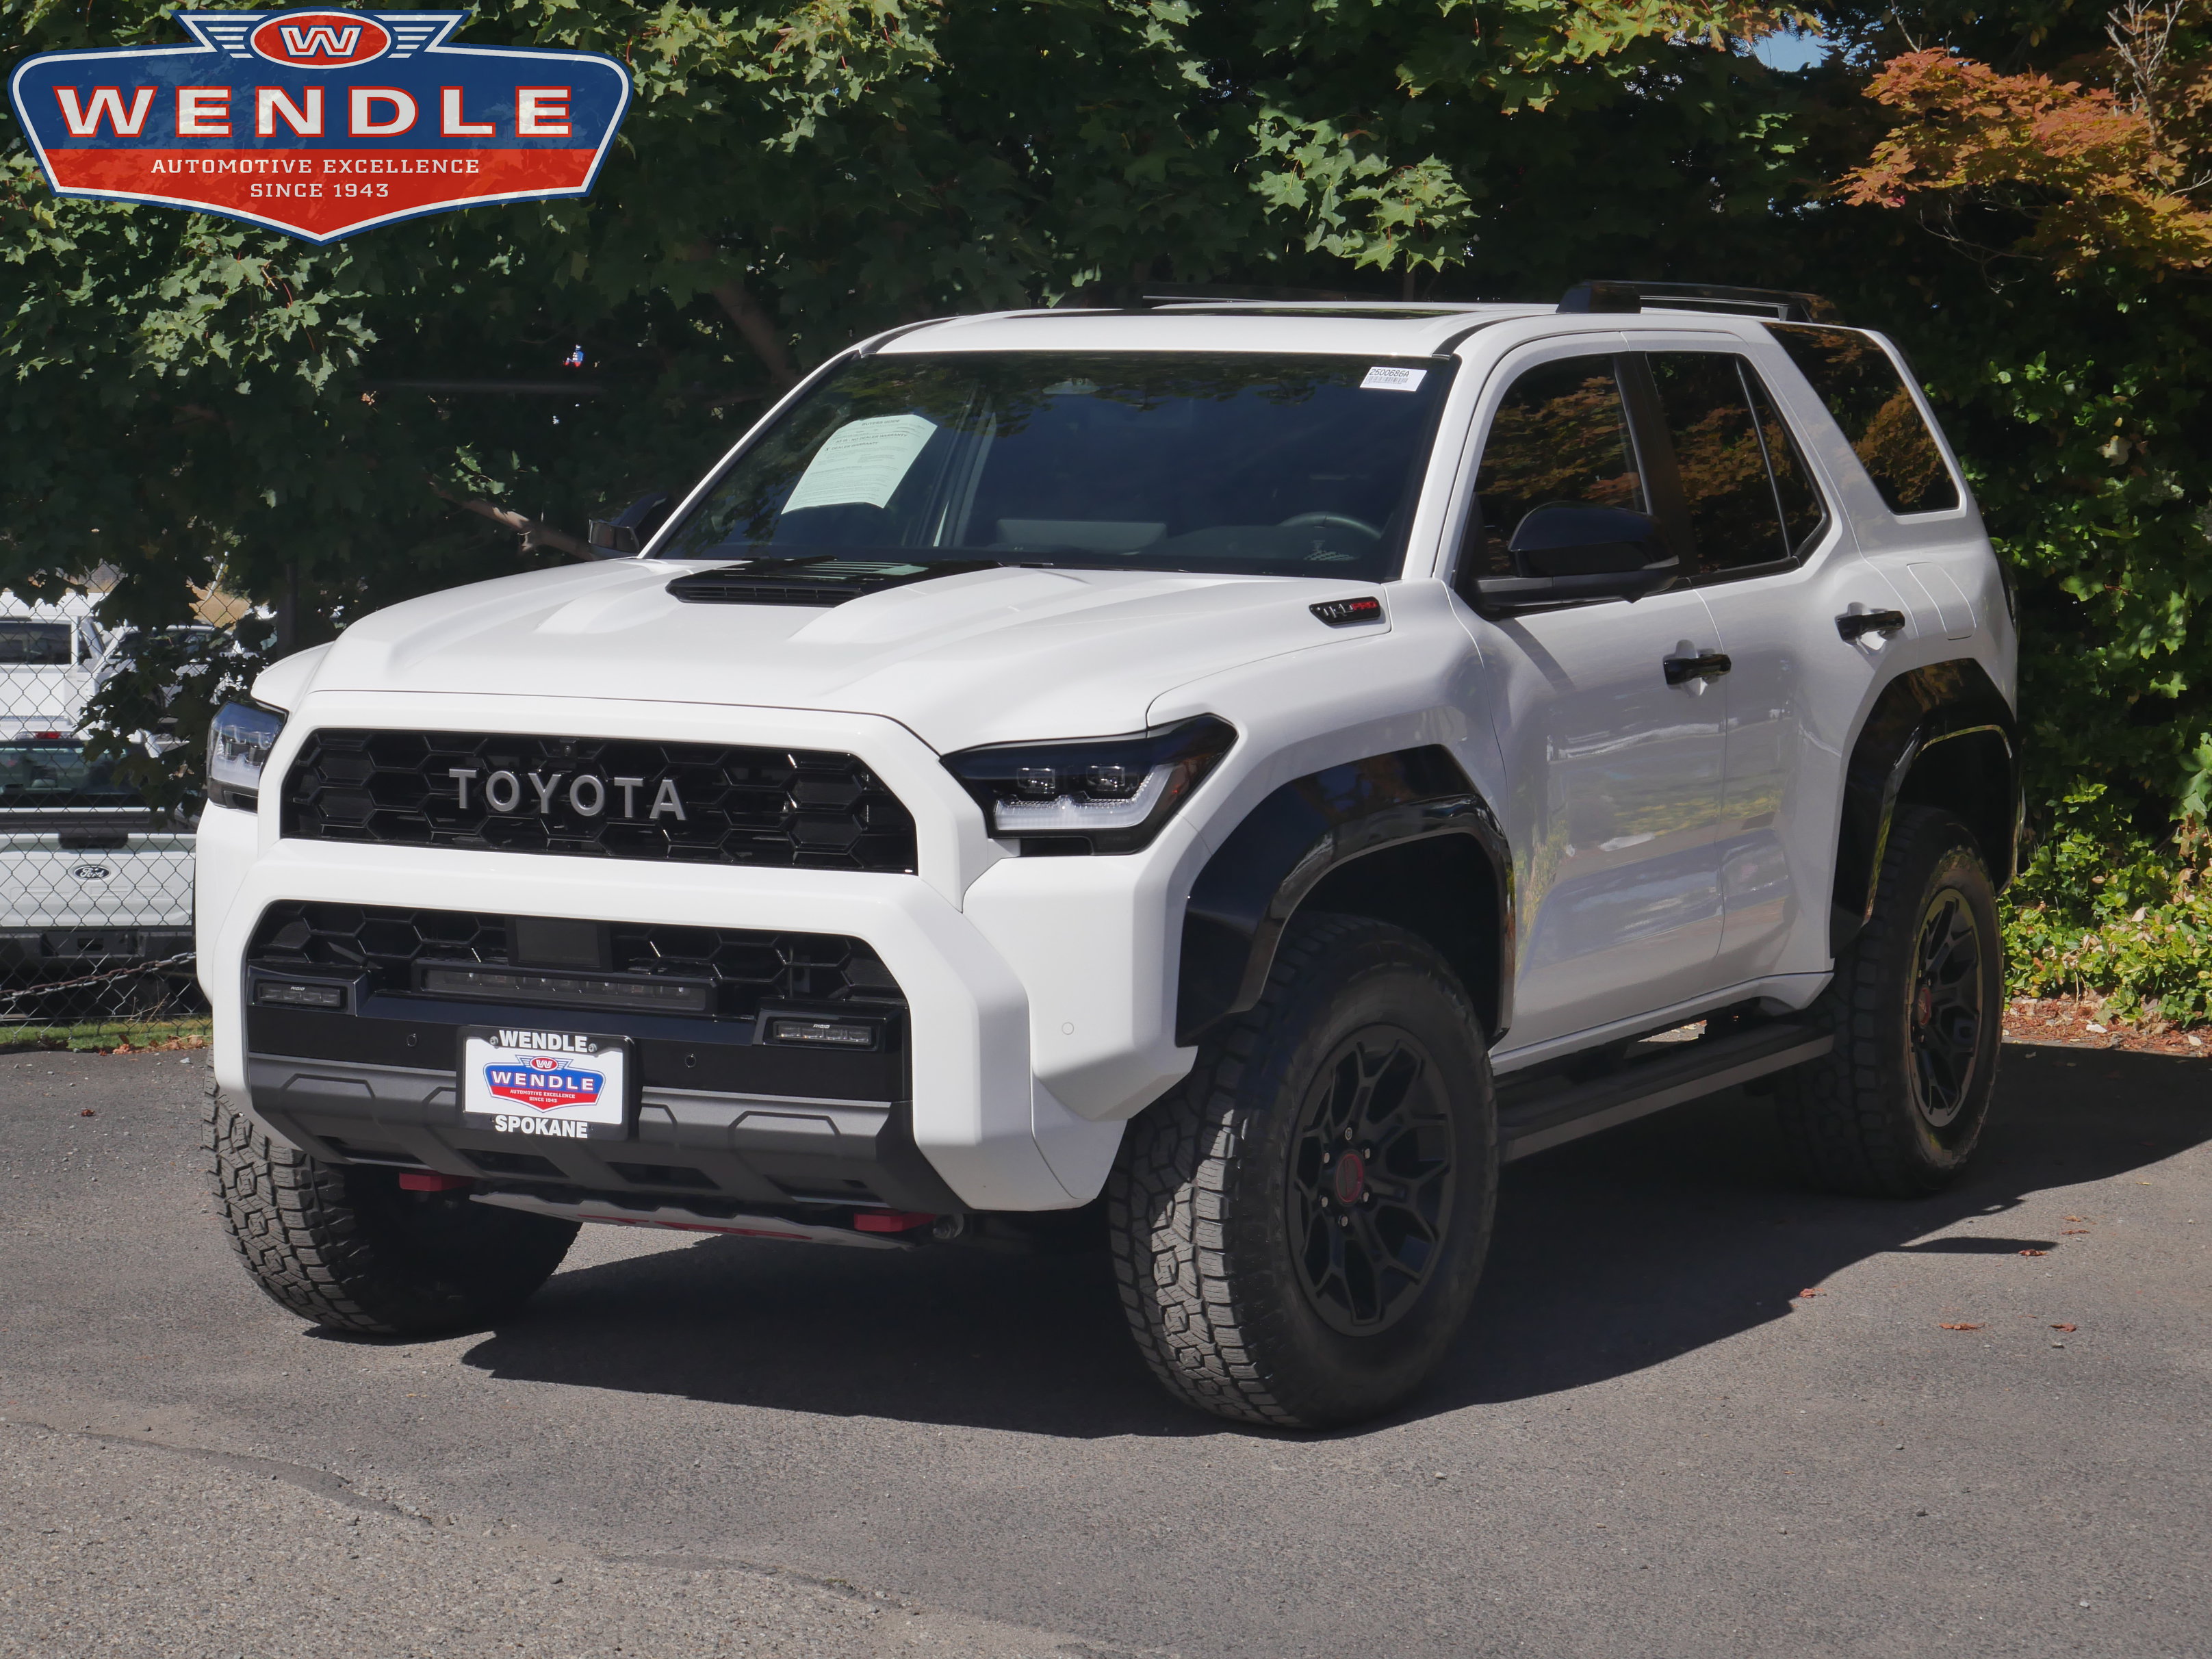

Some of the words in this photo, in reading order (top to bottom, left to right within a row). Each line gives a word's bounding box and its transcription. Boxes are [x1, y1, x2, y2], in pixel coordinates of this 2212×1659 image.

[1369, 369, 1410, 377] 2500686A
[1351, 602, 1378, 610] PRO
[448, 768, 686, 821] TOYOTA
[80, 867, 104, 878] Ford
[499, 1029, 588, 1053] WENDLE
[491, 1070, 594, 1091] WENDLE
[495, 1115, 588, 1139] SPOKANE
